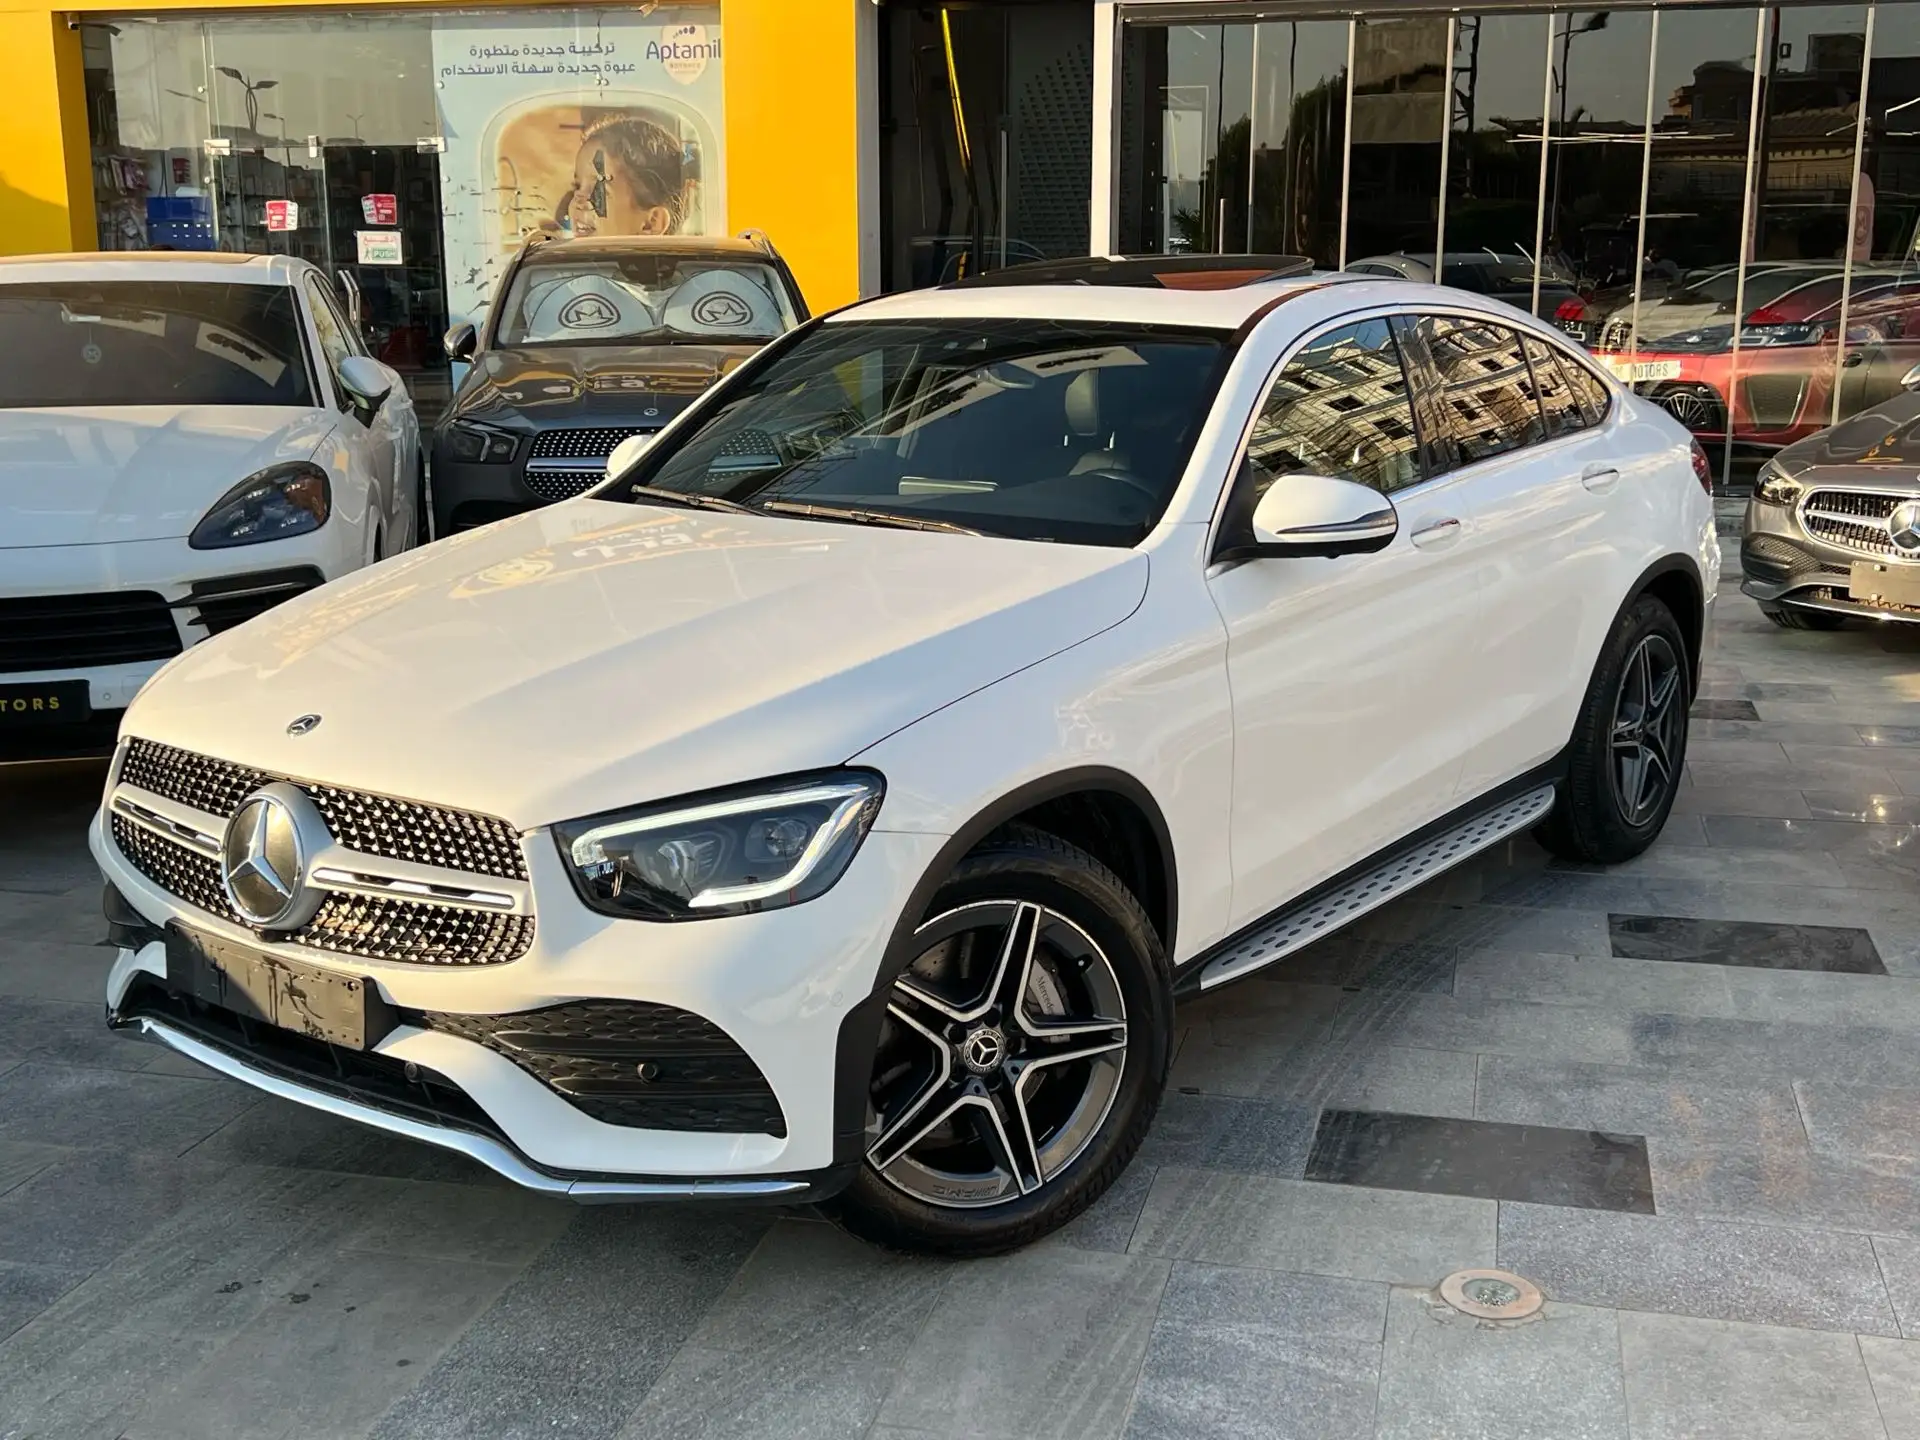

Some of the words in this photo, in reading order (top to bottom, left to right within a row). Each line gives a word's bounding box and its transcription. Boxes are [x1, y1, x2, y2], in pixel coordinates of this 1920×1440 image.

[469, 44, 520, 59] متطورة
[522, 44, 565, 58] جديدة
[568, 41, 615, 56] تركيبة
[646, 39, 721, 63] Aptamil
[441, 63, 508, 77] الاستخدام
[511, 61, 554, 74] سهلة
[557, 62, 601, 75] جديدة
[604, 60, 636, 75] عبوة
[0, 696, 60, 712] TORS
